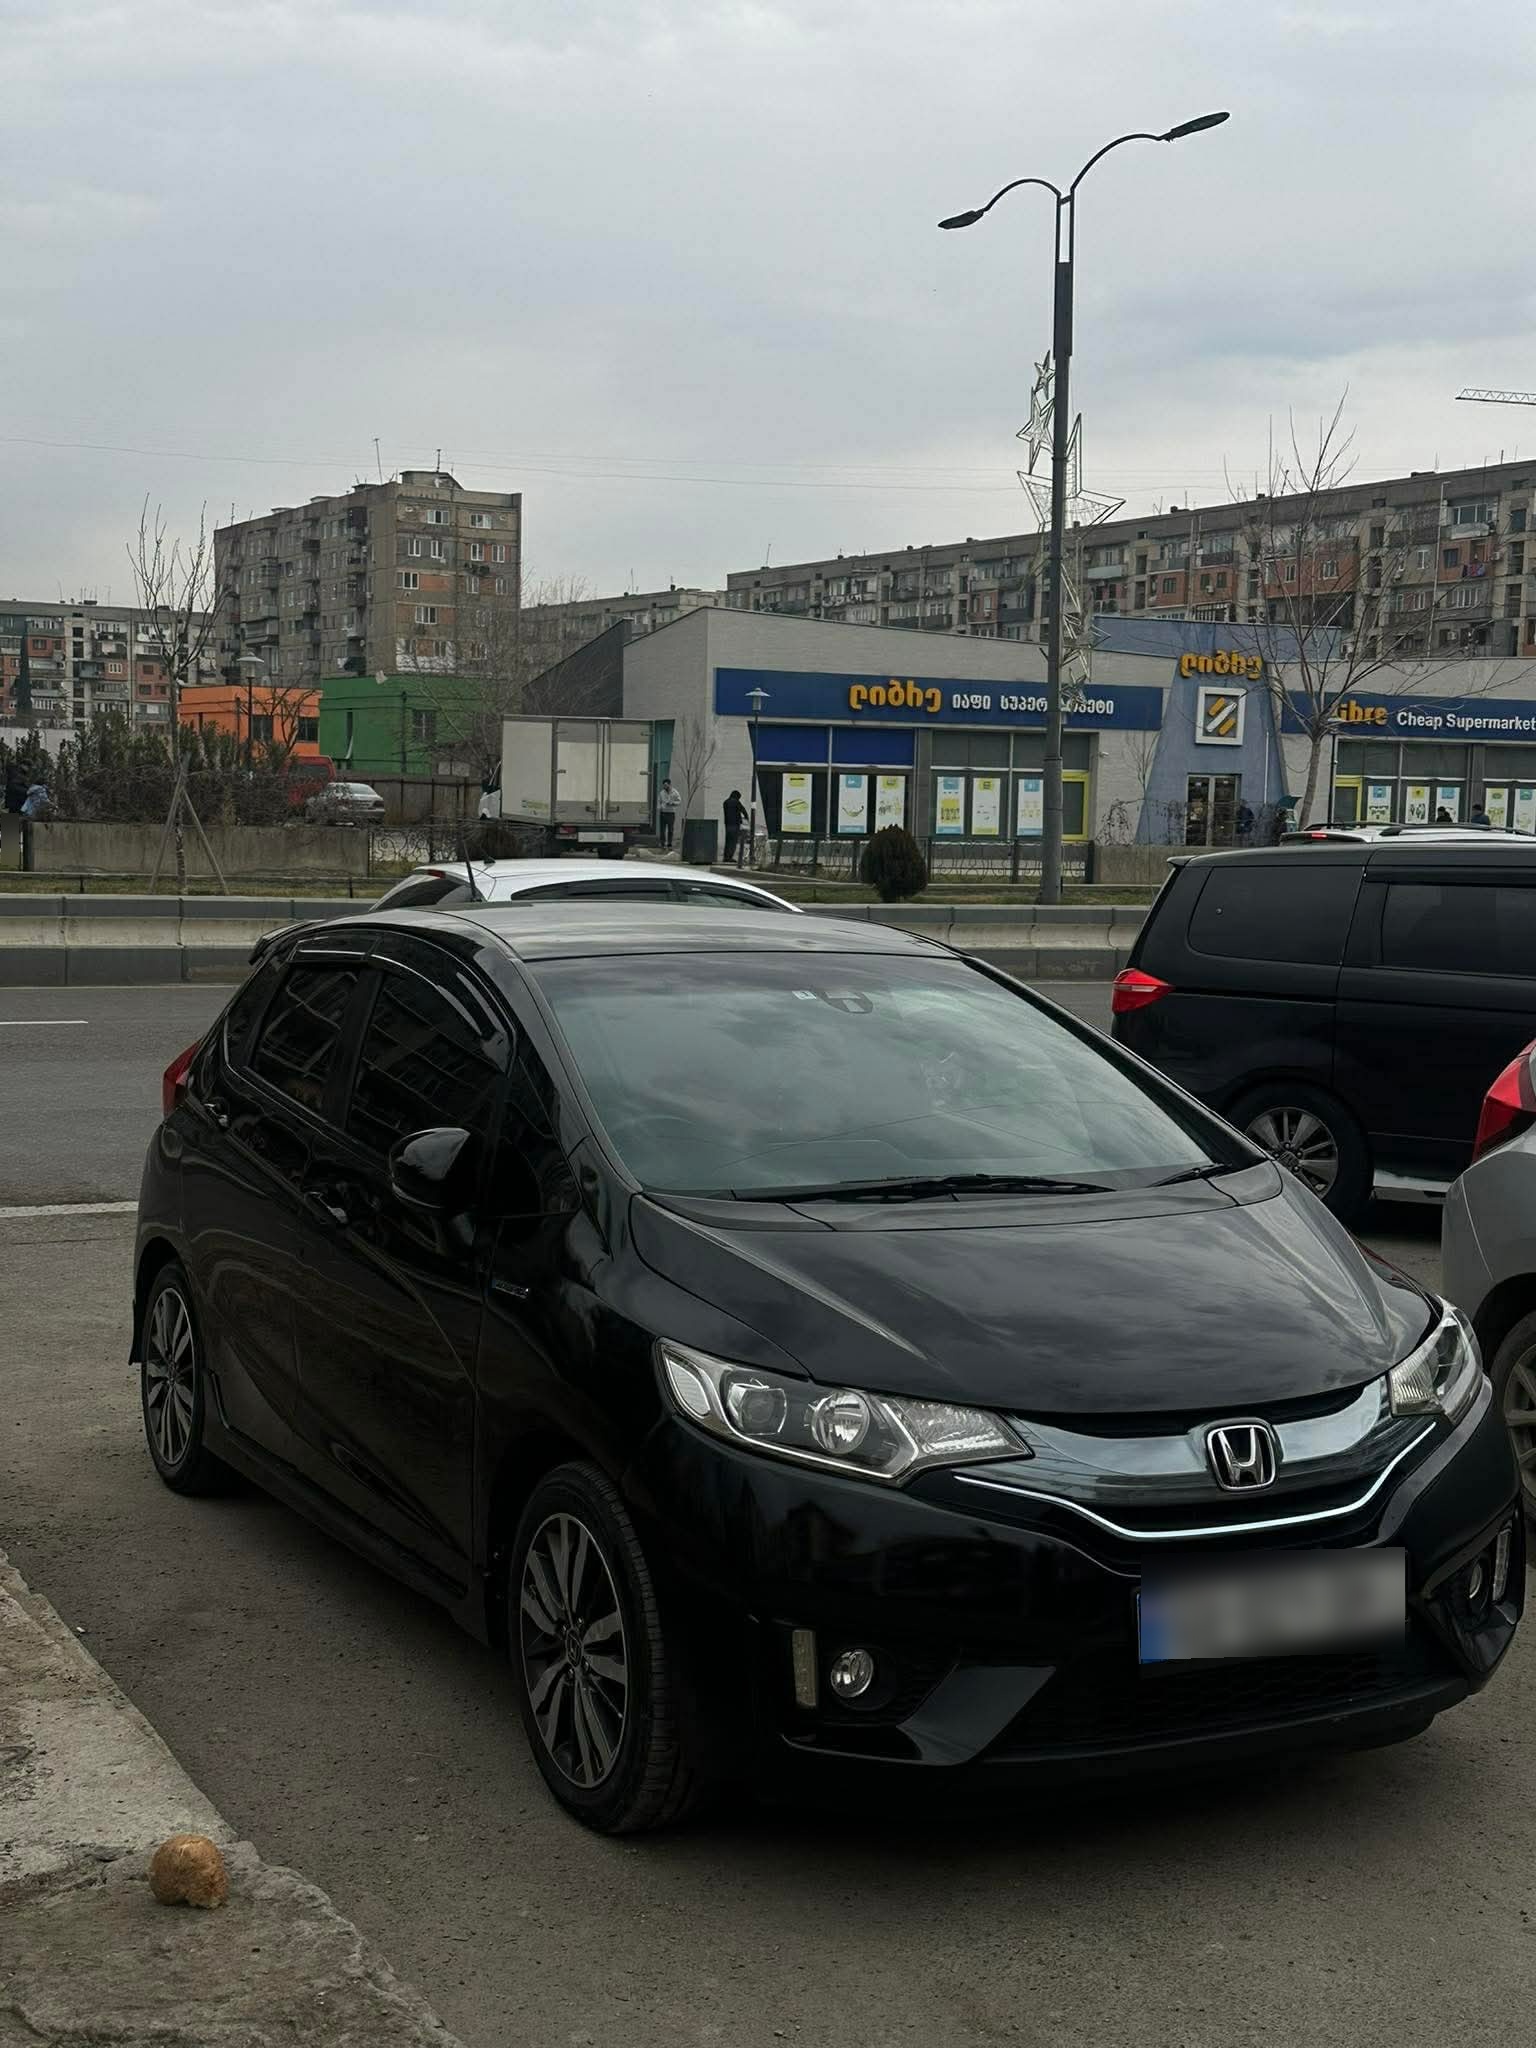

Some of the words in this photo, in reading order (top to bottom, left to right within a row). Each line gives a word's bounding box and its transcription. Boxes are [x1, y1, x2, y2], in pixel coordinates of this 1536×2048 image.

[849, 679, 942, 713] ლიბრე
[952, 694, 991, 710] იაფი
[1396, 711, 1442, 731] Cheap
[1446, 713, 1536, 732] Supermarket
